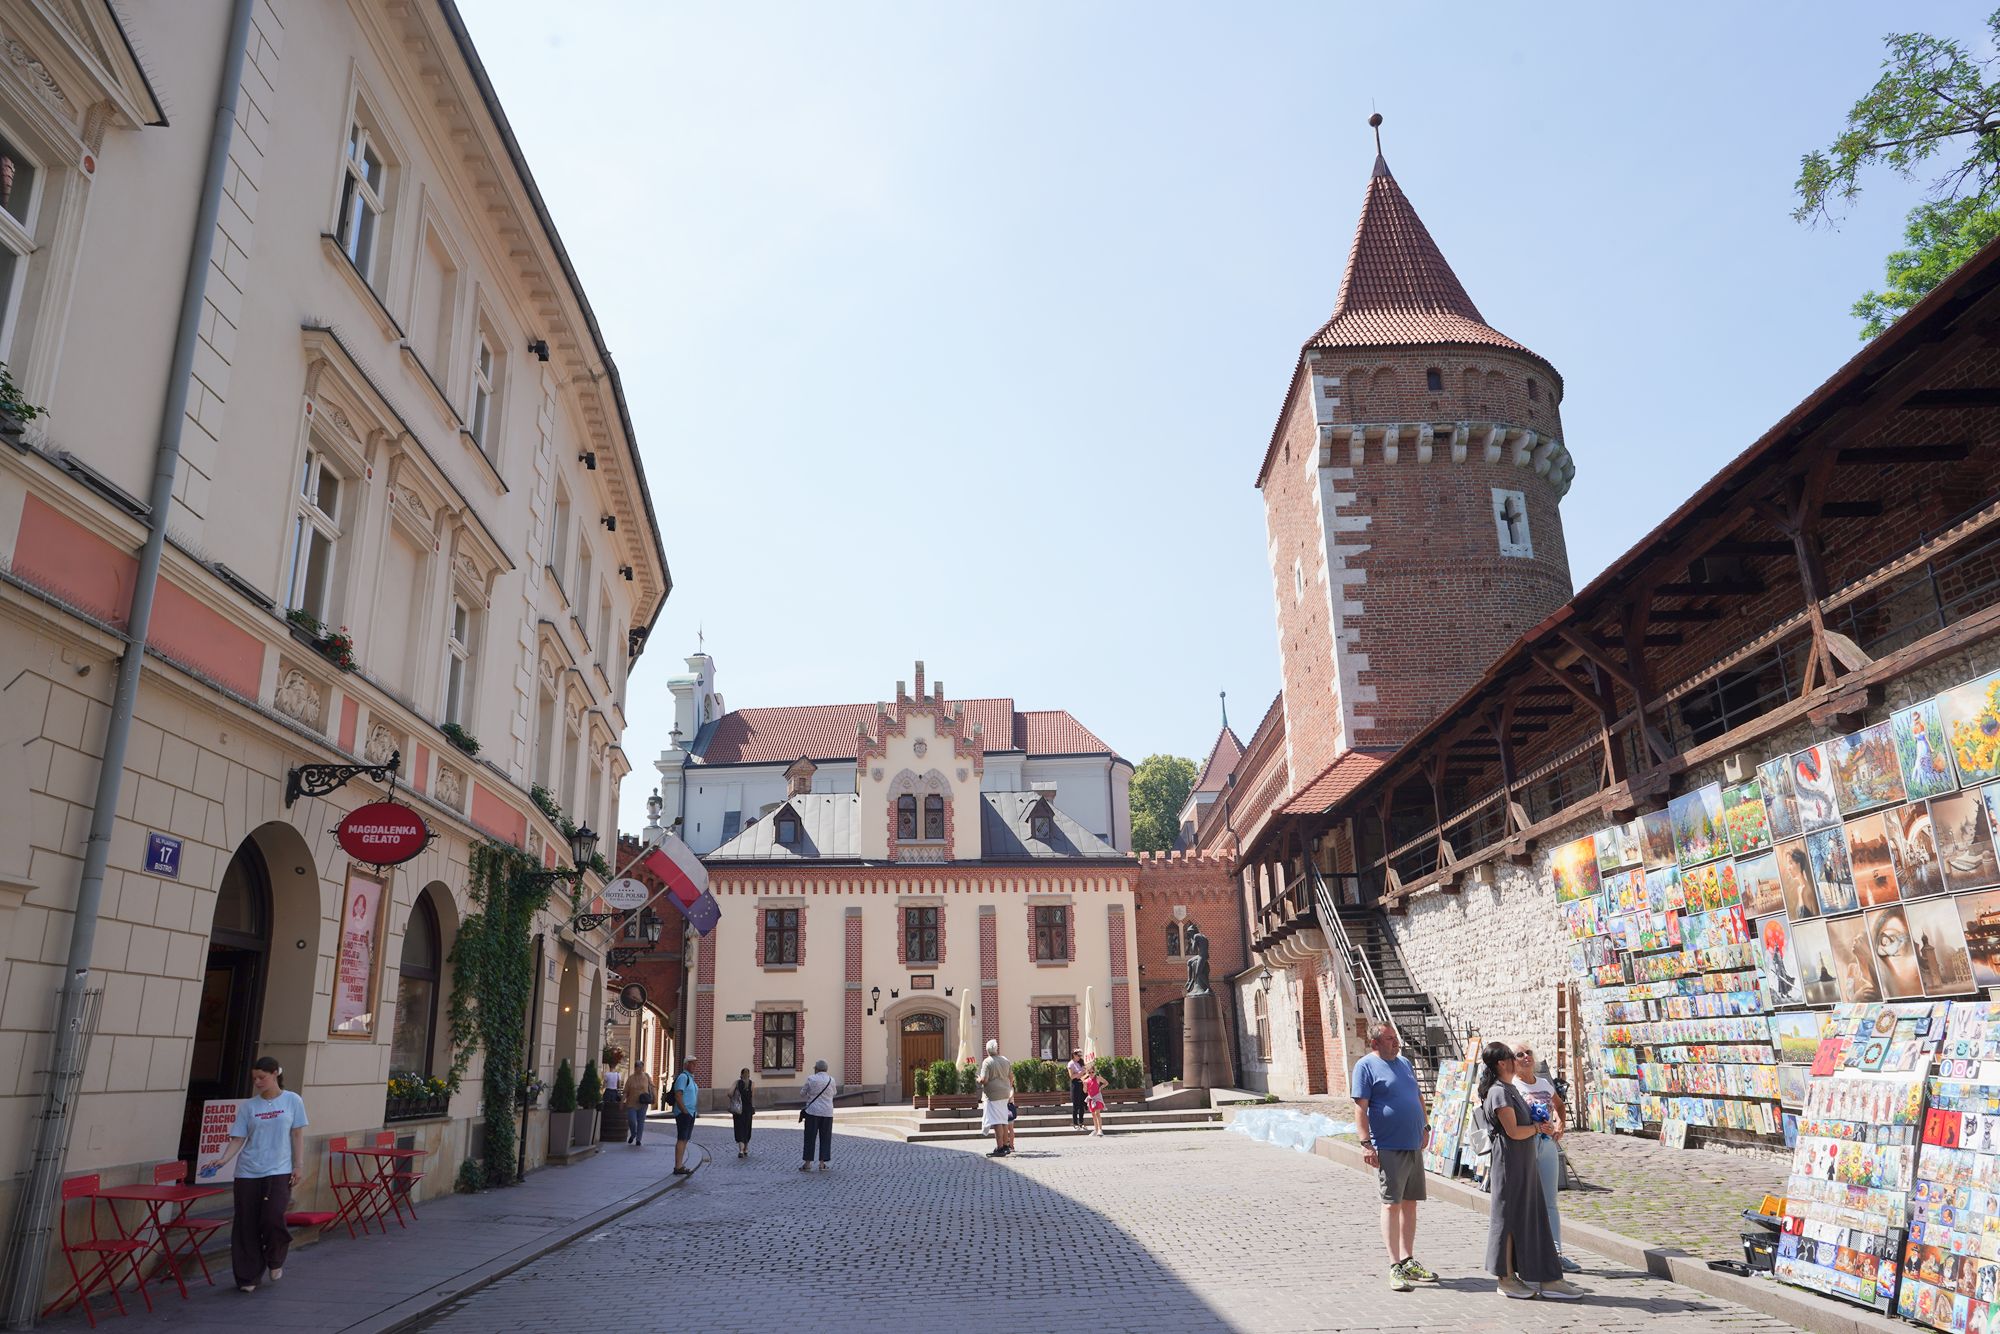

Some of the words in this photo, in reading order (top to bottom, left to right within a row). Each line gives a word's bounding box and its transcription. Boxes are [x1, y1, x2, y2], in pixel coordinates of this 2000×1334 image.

[348, 824, 417, 835] MAGDALENKA
[362, 834, 401, 844] GELATO
[160, 846, 173, 863] 17
[154, 863, 172, 872] BISTRO
[205, 1104, 236, 1114] GELATO
[204, 1114, 236, 1124] CIACHO
[202, 1125, 228, 1134] KAWA
[201, 1135, 205, 1144] I
[207, 1134, 231, 1144] DOBR
[201, 1144, 220, 1154] VIBE
